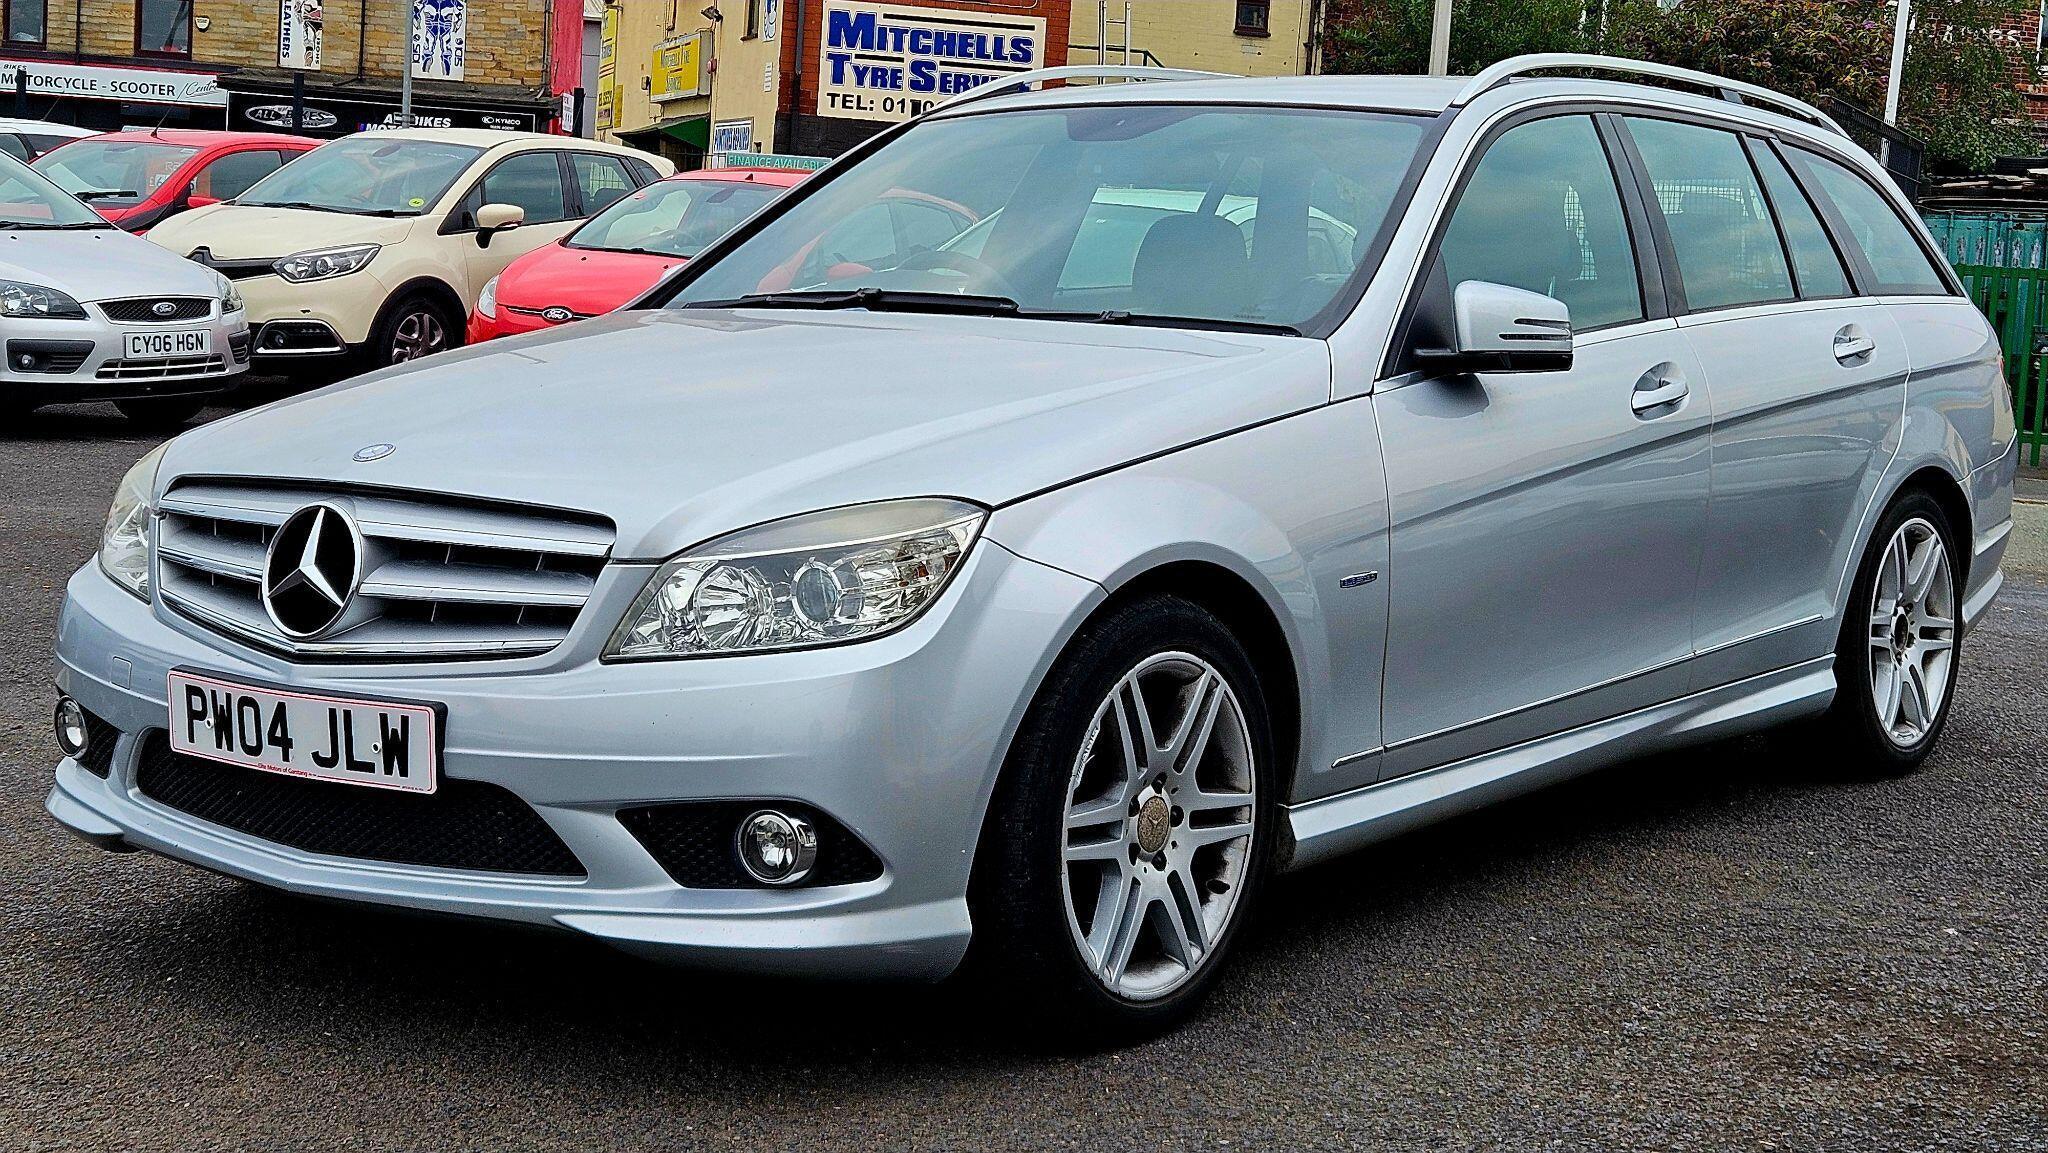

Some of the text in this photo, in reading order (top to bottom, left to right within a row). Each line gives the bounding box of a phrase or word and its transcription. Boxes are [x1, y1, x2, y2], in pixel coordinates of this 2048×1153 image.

[827, 9, 1034, 65] MITCHELLS
[1, 73, 97, 91] MTORCYCLE
[110, 81, 175, 97] SCOOTER
[826, 52, 1031, 96] TYRE SERV
[827, 92, 874, 112] TEL:
[728, 156, 772, 168] FINANCE
[132, 333, 203, 353] CY06 HGN
[185, 684, 409, 778] PW04 JLW
